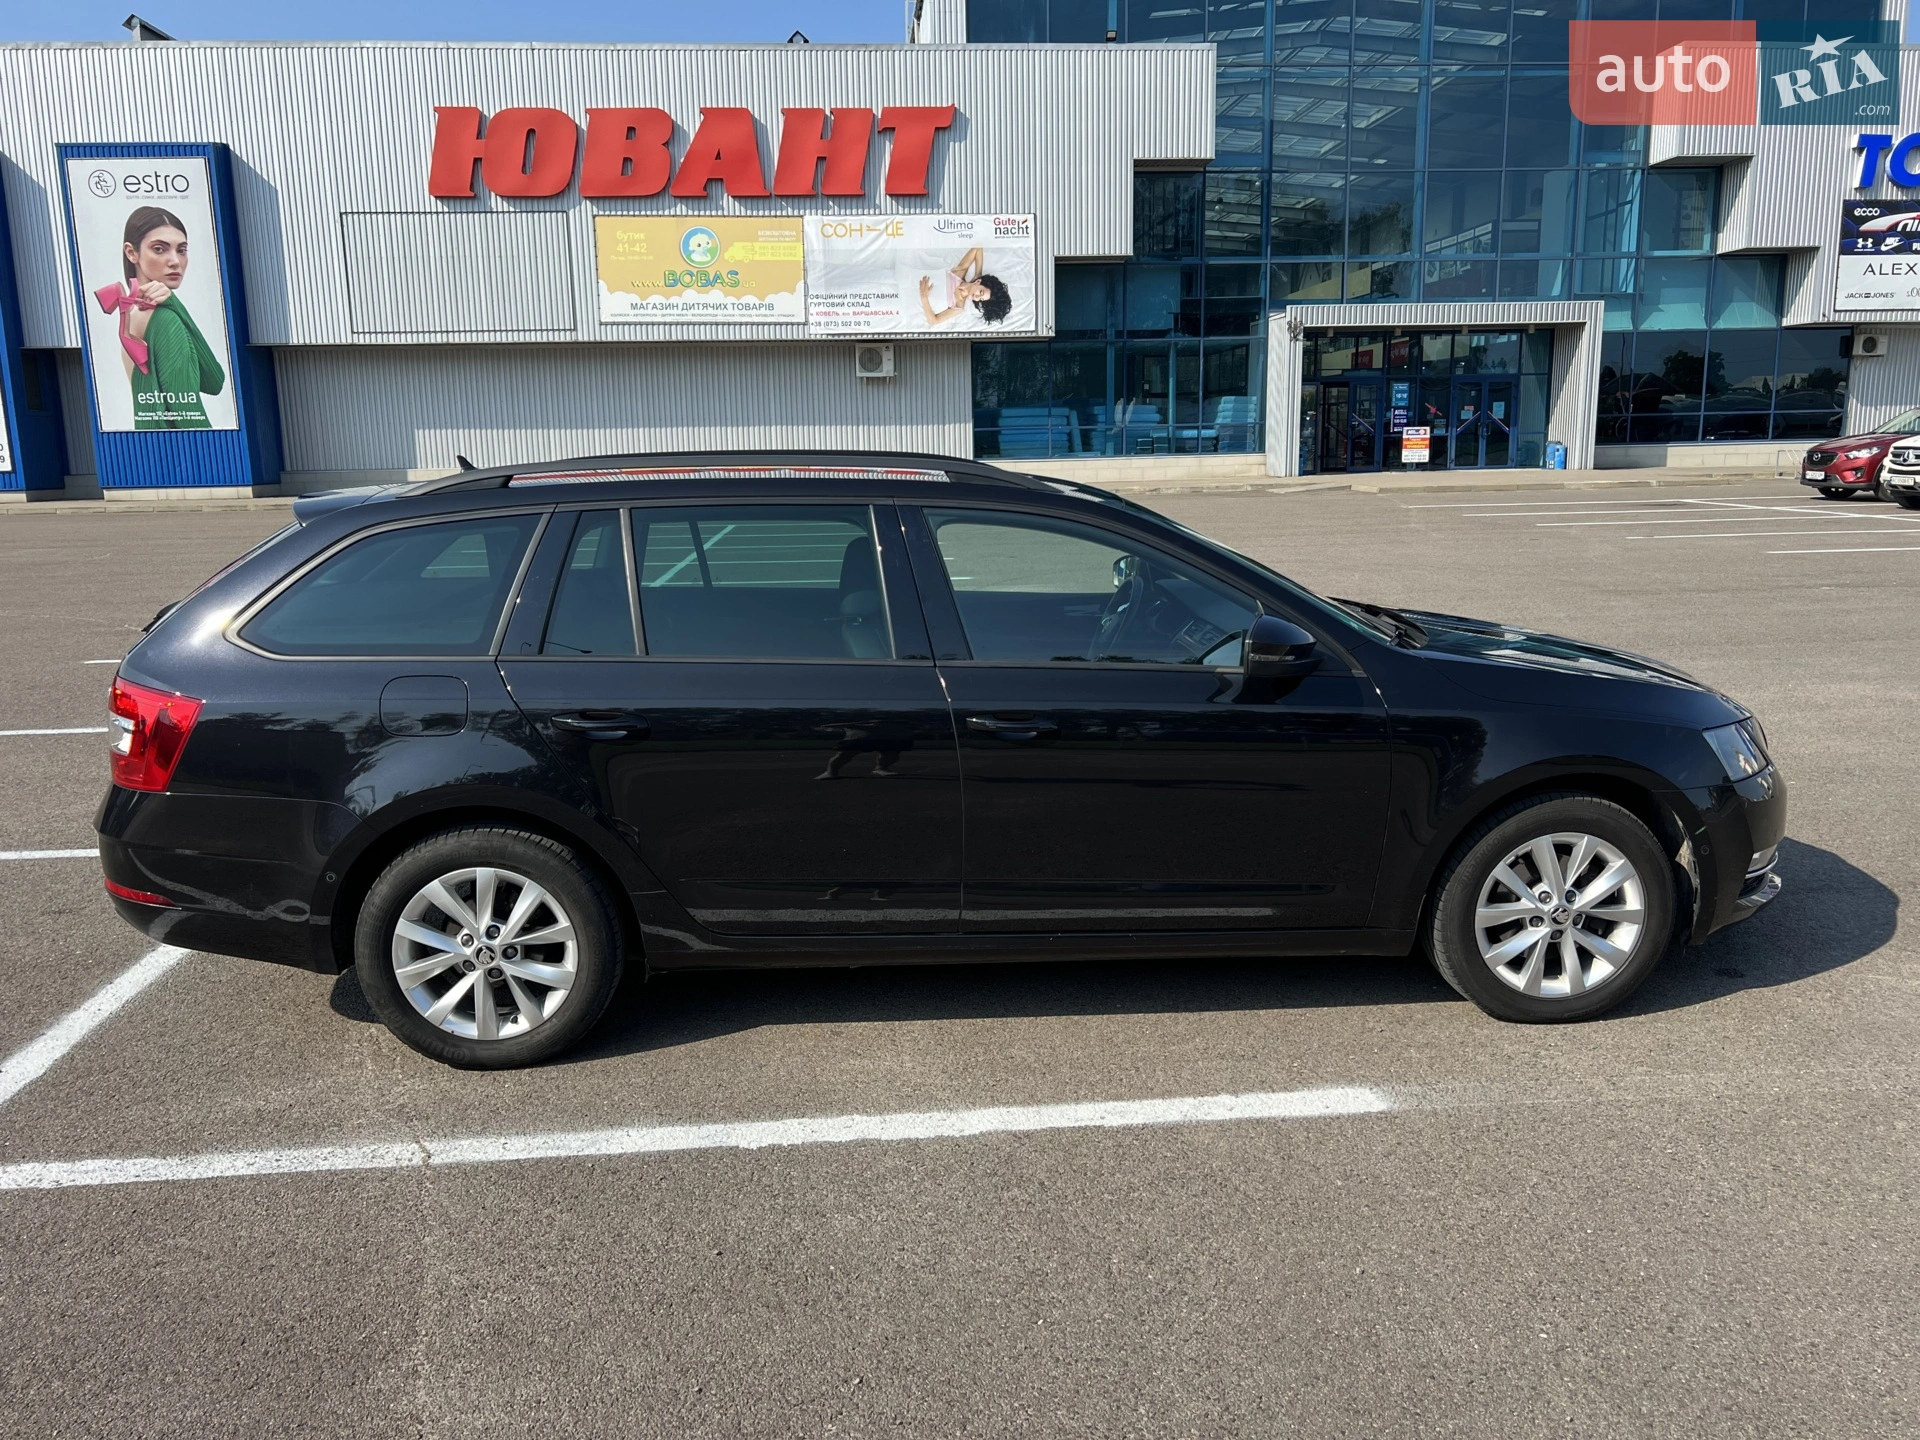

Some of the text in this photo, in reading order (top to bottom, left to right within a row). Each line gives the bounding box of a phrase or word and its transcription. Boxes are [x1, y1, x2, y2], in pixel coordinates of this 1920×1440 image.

[428, 103, 956, 198] ЮВАНТ
[123, 171, 190, 193] estro
[1854, 208, 1880, 216] ecco
[937, 218, 974, 231] Ultima
[993, 216, 1017, 226] Gute
[820, 222, 863, 238] СОН
[994, 220, 1030, 236] nacht
[616, 230, 646, 242] бутик
[616, 242, 648, 253] 41-42
[1862, 262, 1918, 276] ALEX
[630, 302, 774, 311] МАГАЗИН ДИТЯЧИХ ТОВАРІВ
[138, 390, 197, 404] estro.ua
